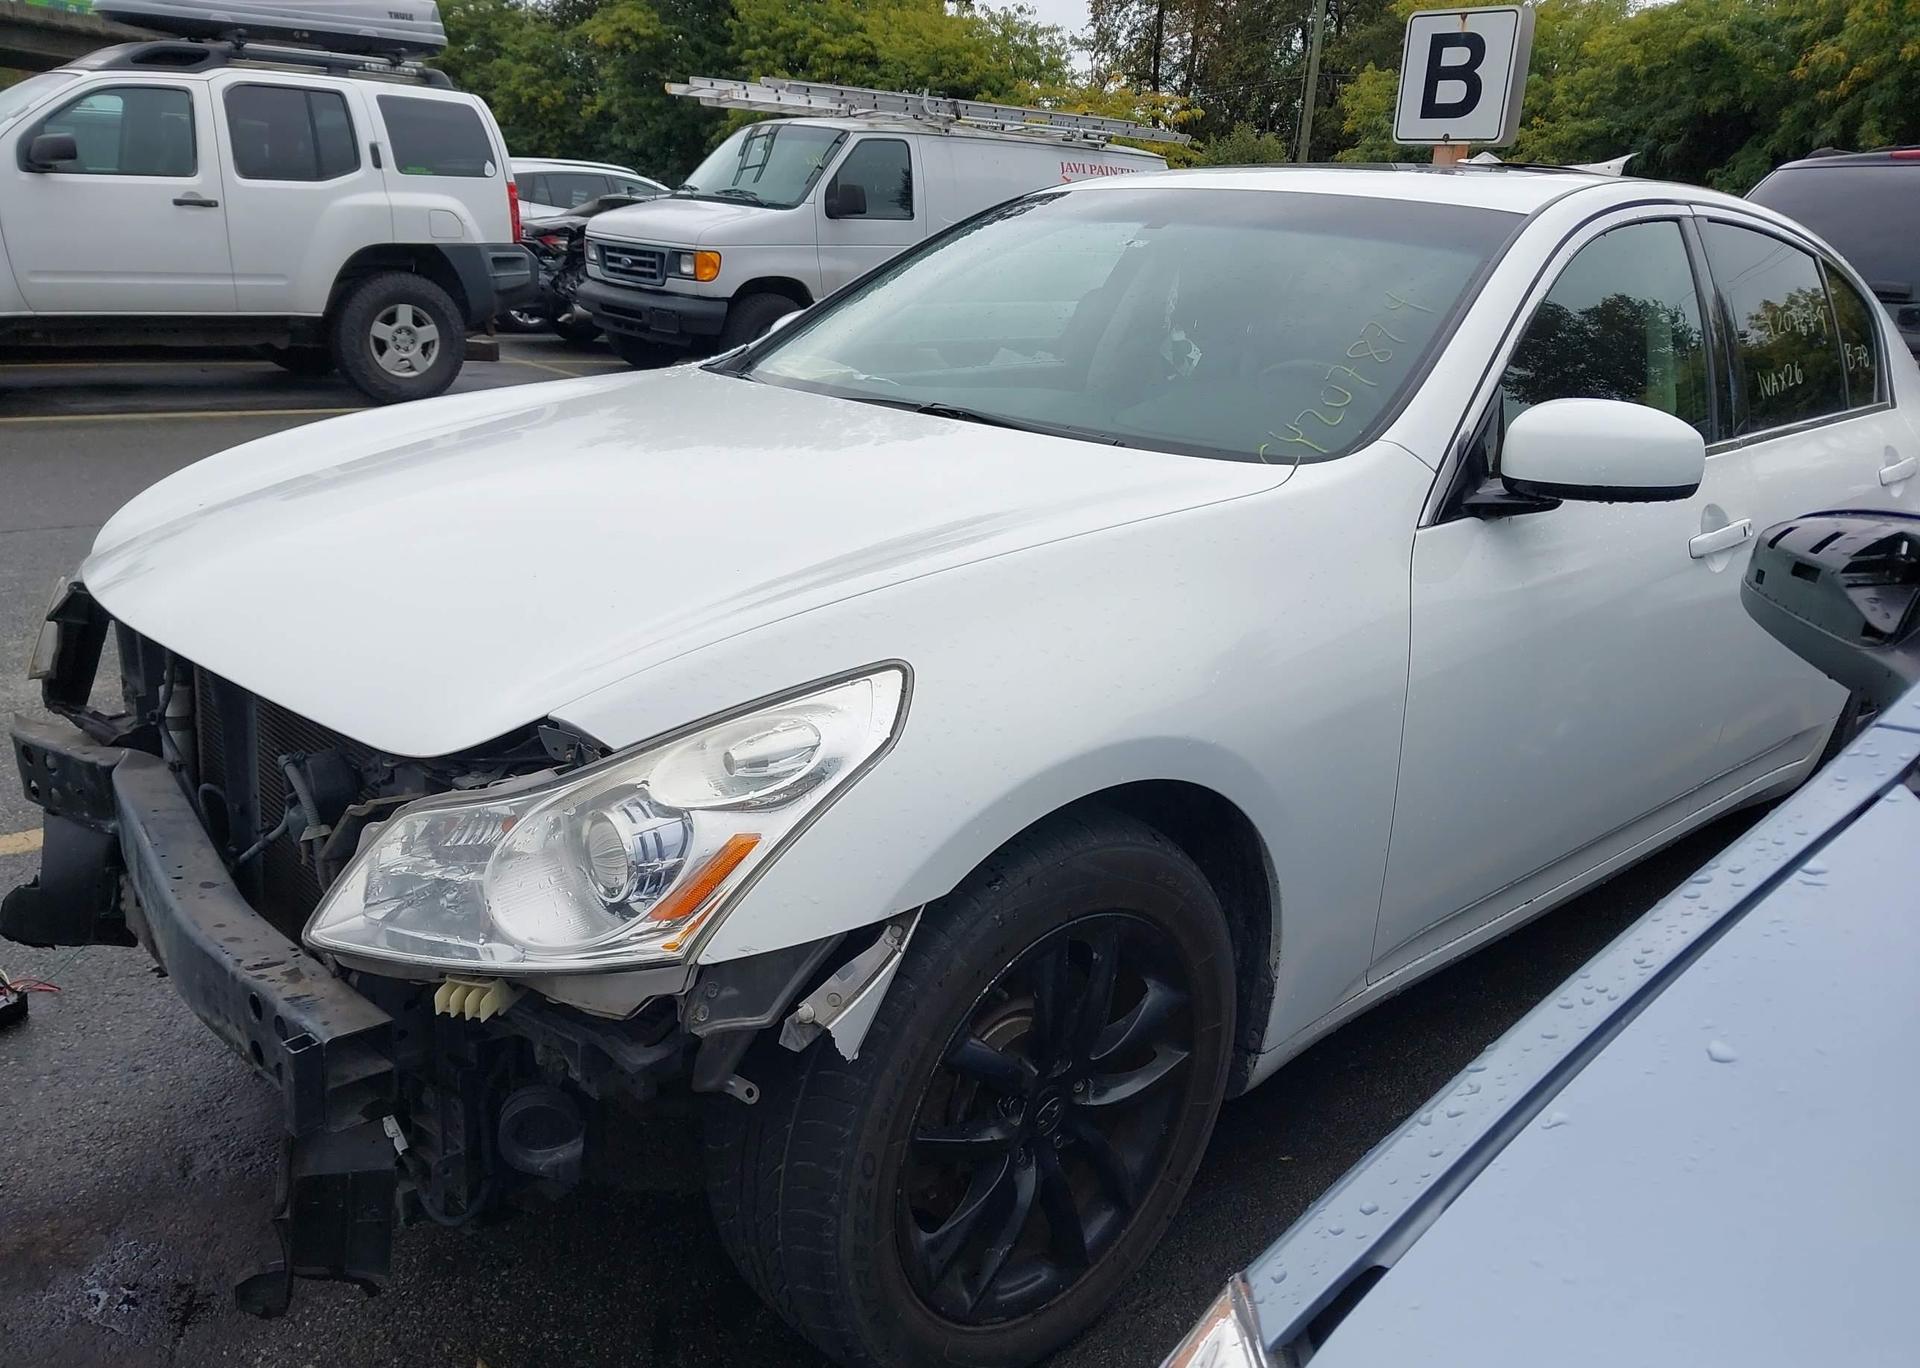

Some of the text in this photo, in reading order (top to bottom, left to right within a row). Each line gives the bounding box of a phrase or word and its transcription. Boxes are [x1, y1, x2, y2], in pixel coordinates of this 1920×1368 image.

[388, 11, 414, 21] THULE
[1419, 31, 1487, 119] B
[1060, 161, 1086, 175] JAVI
